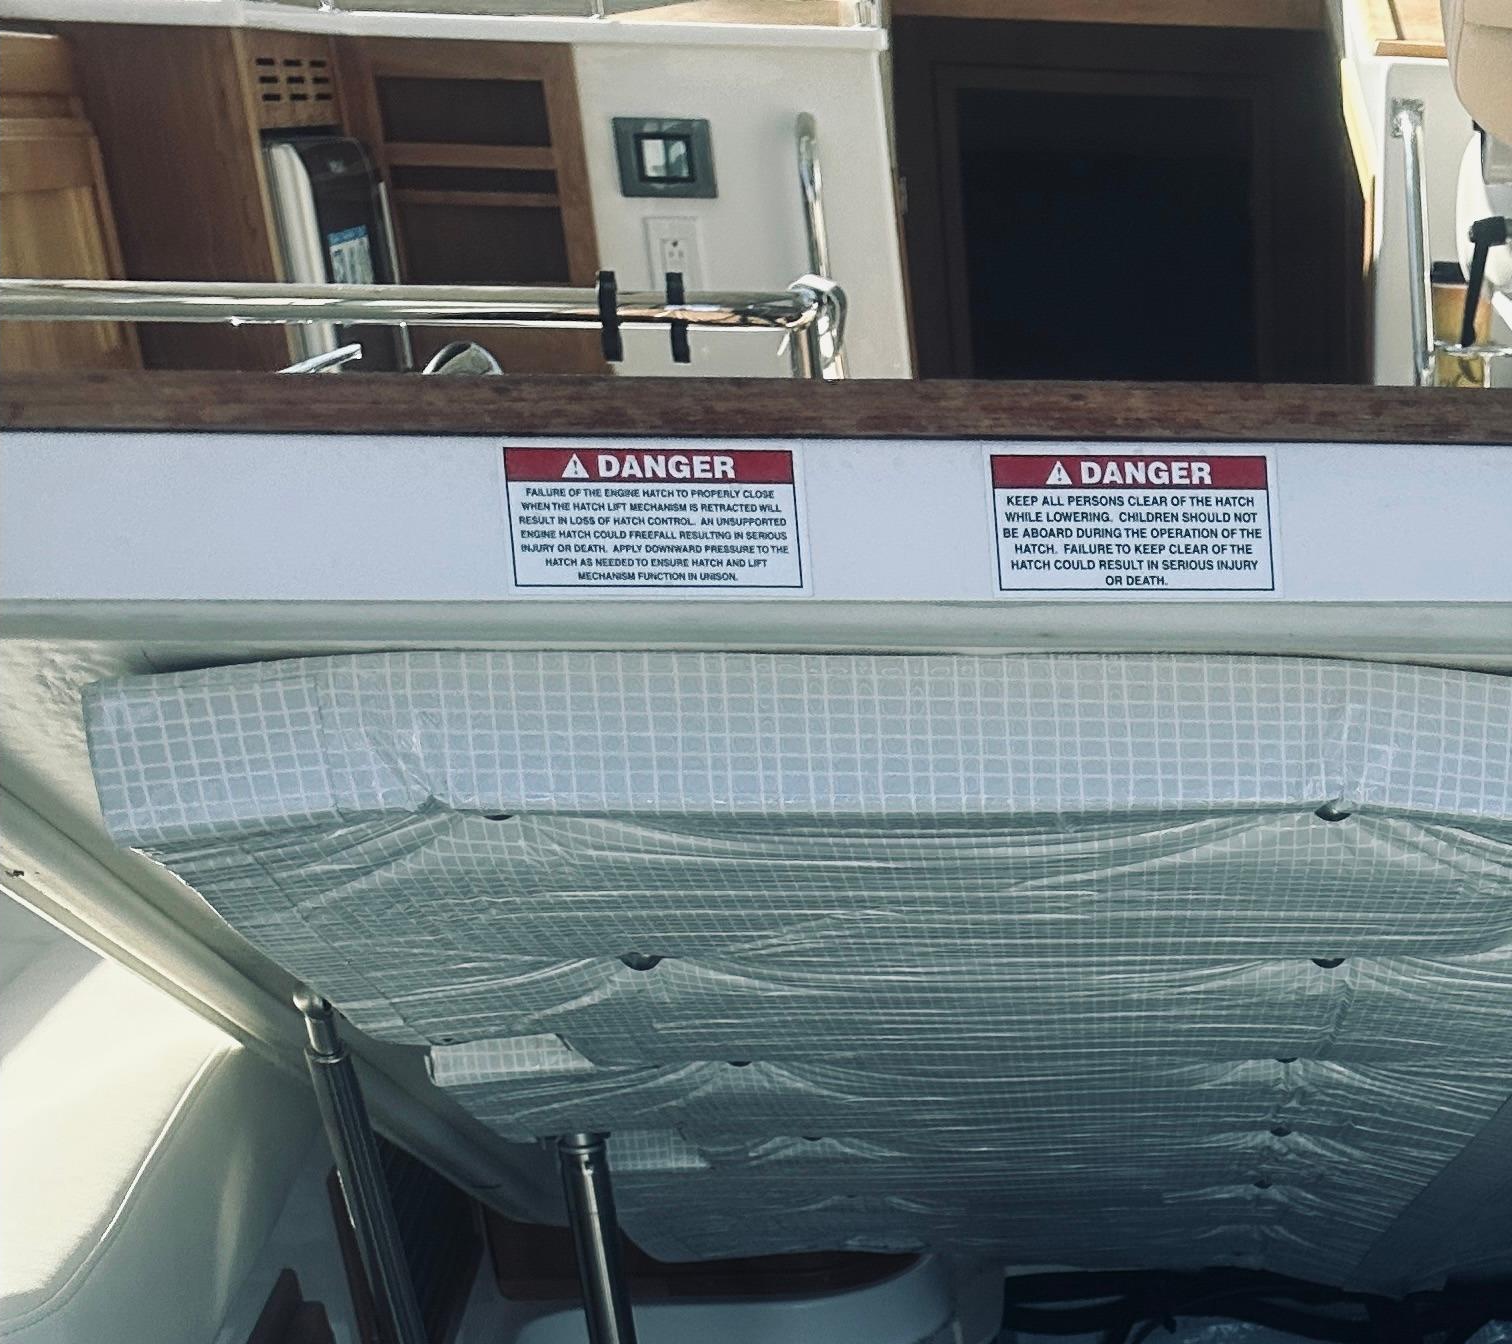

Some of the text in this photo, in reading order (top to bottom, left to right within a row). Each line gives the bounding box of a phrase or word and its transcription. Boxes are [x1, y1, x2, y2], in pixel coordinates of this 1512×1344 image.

[597, 455, 736, 479] DANGER
[1080, 461, 1212, 485] DANGER
[525, 487, 774, 500] FAILURE OF THE ENGINE HATCH TO PROPERLY CLOSE
[1006, 496, 1254, 507] KEEP ALL PERSONS CLEAR OF THE HATCH
[521, 502, 782, 513] WHEN THE HATCH LIFT MECHANISM IS RETRACTED WILL
[518, 515, 556, 526] RESULT
[557, 516, 566, 526] IN
[569, 516, 596, 526] LOSS
[597, 516, 611, 526] OF
[613, 516, 646, 526] HATCH
[700, 516, 714, 527] AN
[716, 517, 787, 527] UNSUPPORTED
[1005, 512, 1043, 523] WHILE
[1118, 512, 1179, 523] CHILDREN
[1182, 512, 1231, 523] SHOULD
[1234, 512, 1258, 523] NOT
[520, 530, 787, 541] ENGINE HATCH COULD FREEFALL RESULTING IN SERIOUS
[1002, 528, 1262, 539] BE ABOARD DURING THE OPERATION OF THE
[521, 543, 555, 553] INJURY
[557, 543, 572, 553] OR
[612, 544, 642, 553] APPLY
[645, 544, 702, 554] DOWNWARD
[704, 544, 755, 554] PRESSURE
[757, 544, 769, 554] TO
[771, 544, 789, 554] THE
[1064, 543, 1113, 555] FAILURE
[1115, 543, 1132, 555] TO
[1134, 543, 1166, 555] KEEP
[1169, 543, 1209, 555] CLEAR
[1211, 543, 1229, 555] OF
[1230, 543, 1253, 555] THE
[545, 557, 767, 568] HATCH AS NEEDED TO ENSURE HATCH AND LIFT
[1010, 559, 1258, 571] HATCH COULD RESULT IN SERIOUS INJURY
[577, 571, 636, 581] MECHANISM
[638, 571, 686, 581] FUNCTION
[688, 572, 697, 582] IN
[1105, 575, 1124, 586] OR
